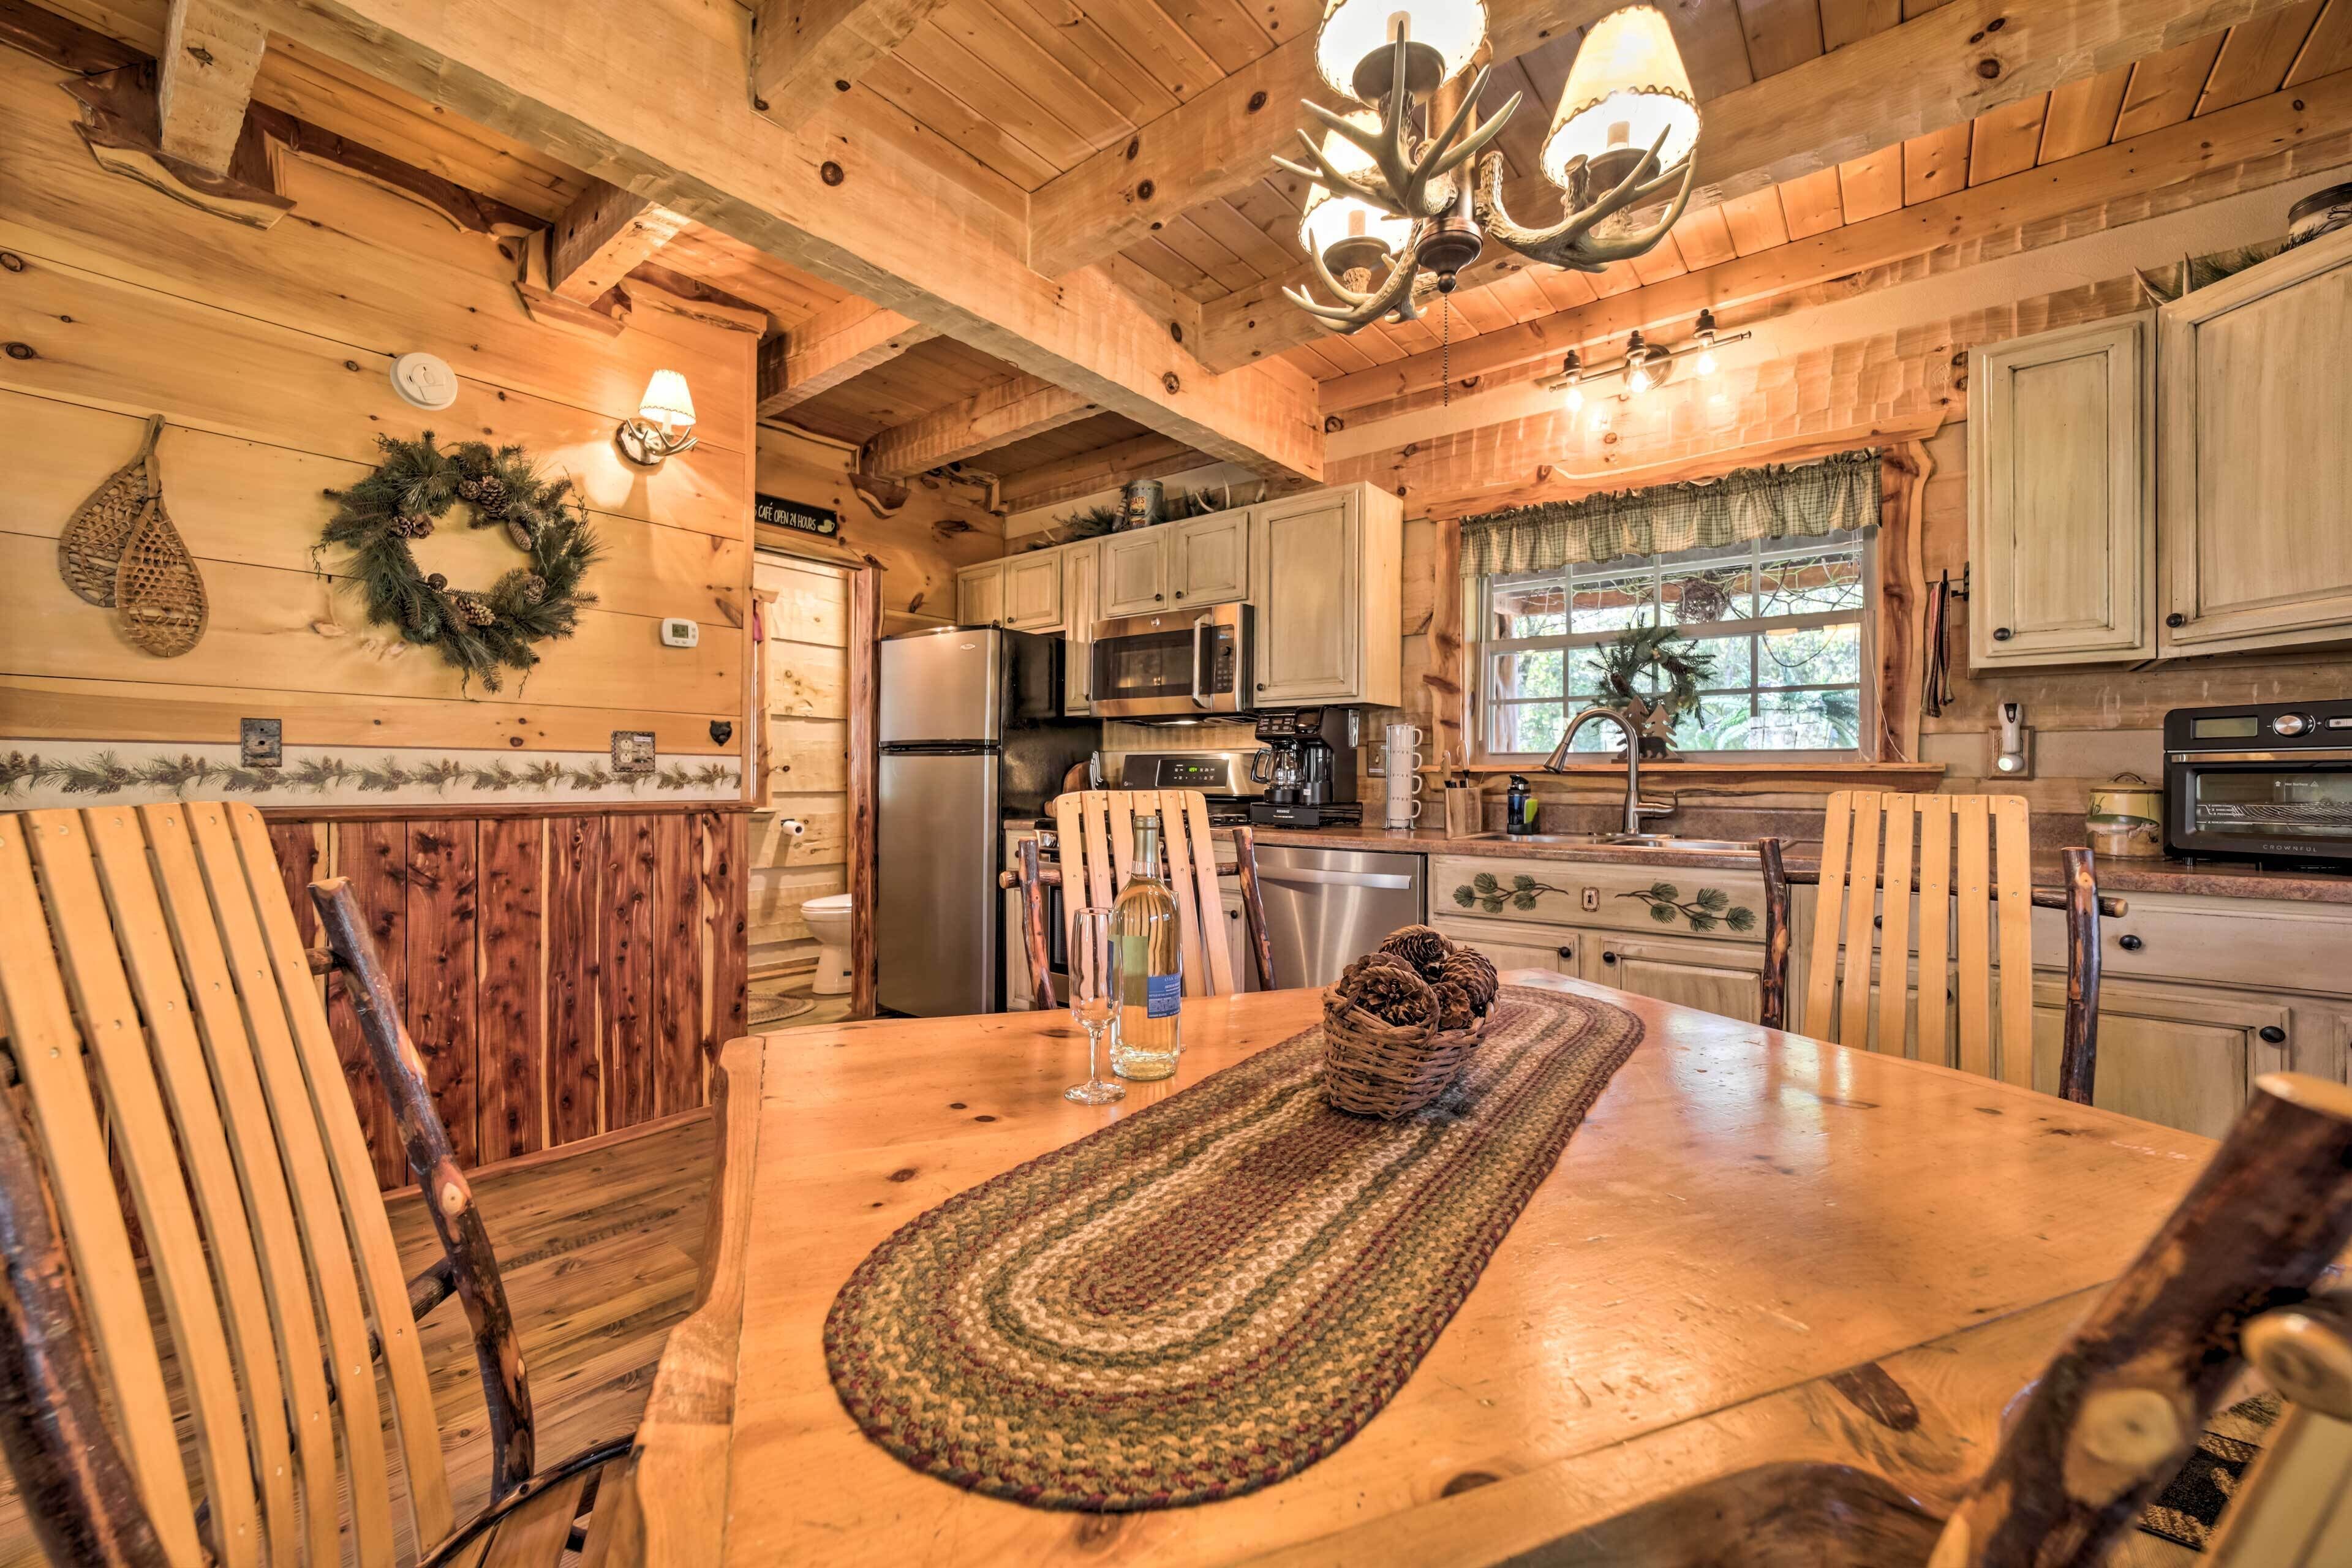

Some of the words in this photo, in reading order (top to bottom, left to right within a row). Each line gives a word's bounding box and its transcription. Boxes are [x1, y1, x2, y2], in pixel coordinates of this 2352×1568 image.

[758, 502, 772, 521] CAFÉ
[774, 510, 789, 524] OPEN
[790, 513, 796, 527] 24
[797, 514, 816, 531] HOURS
[2263, 844, 2317, 853] CROWNFUL
